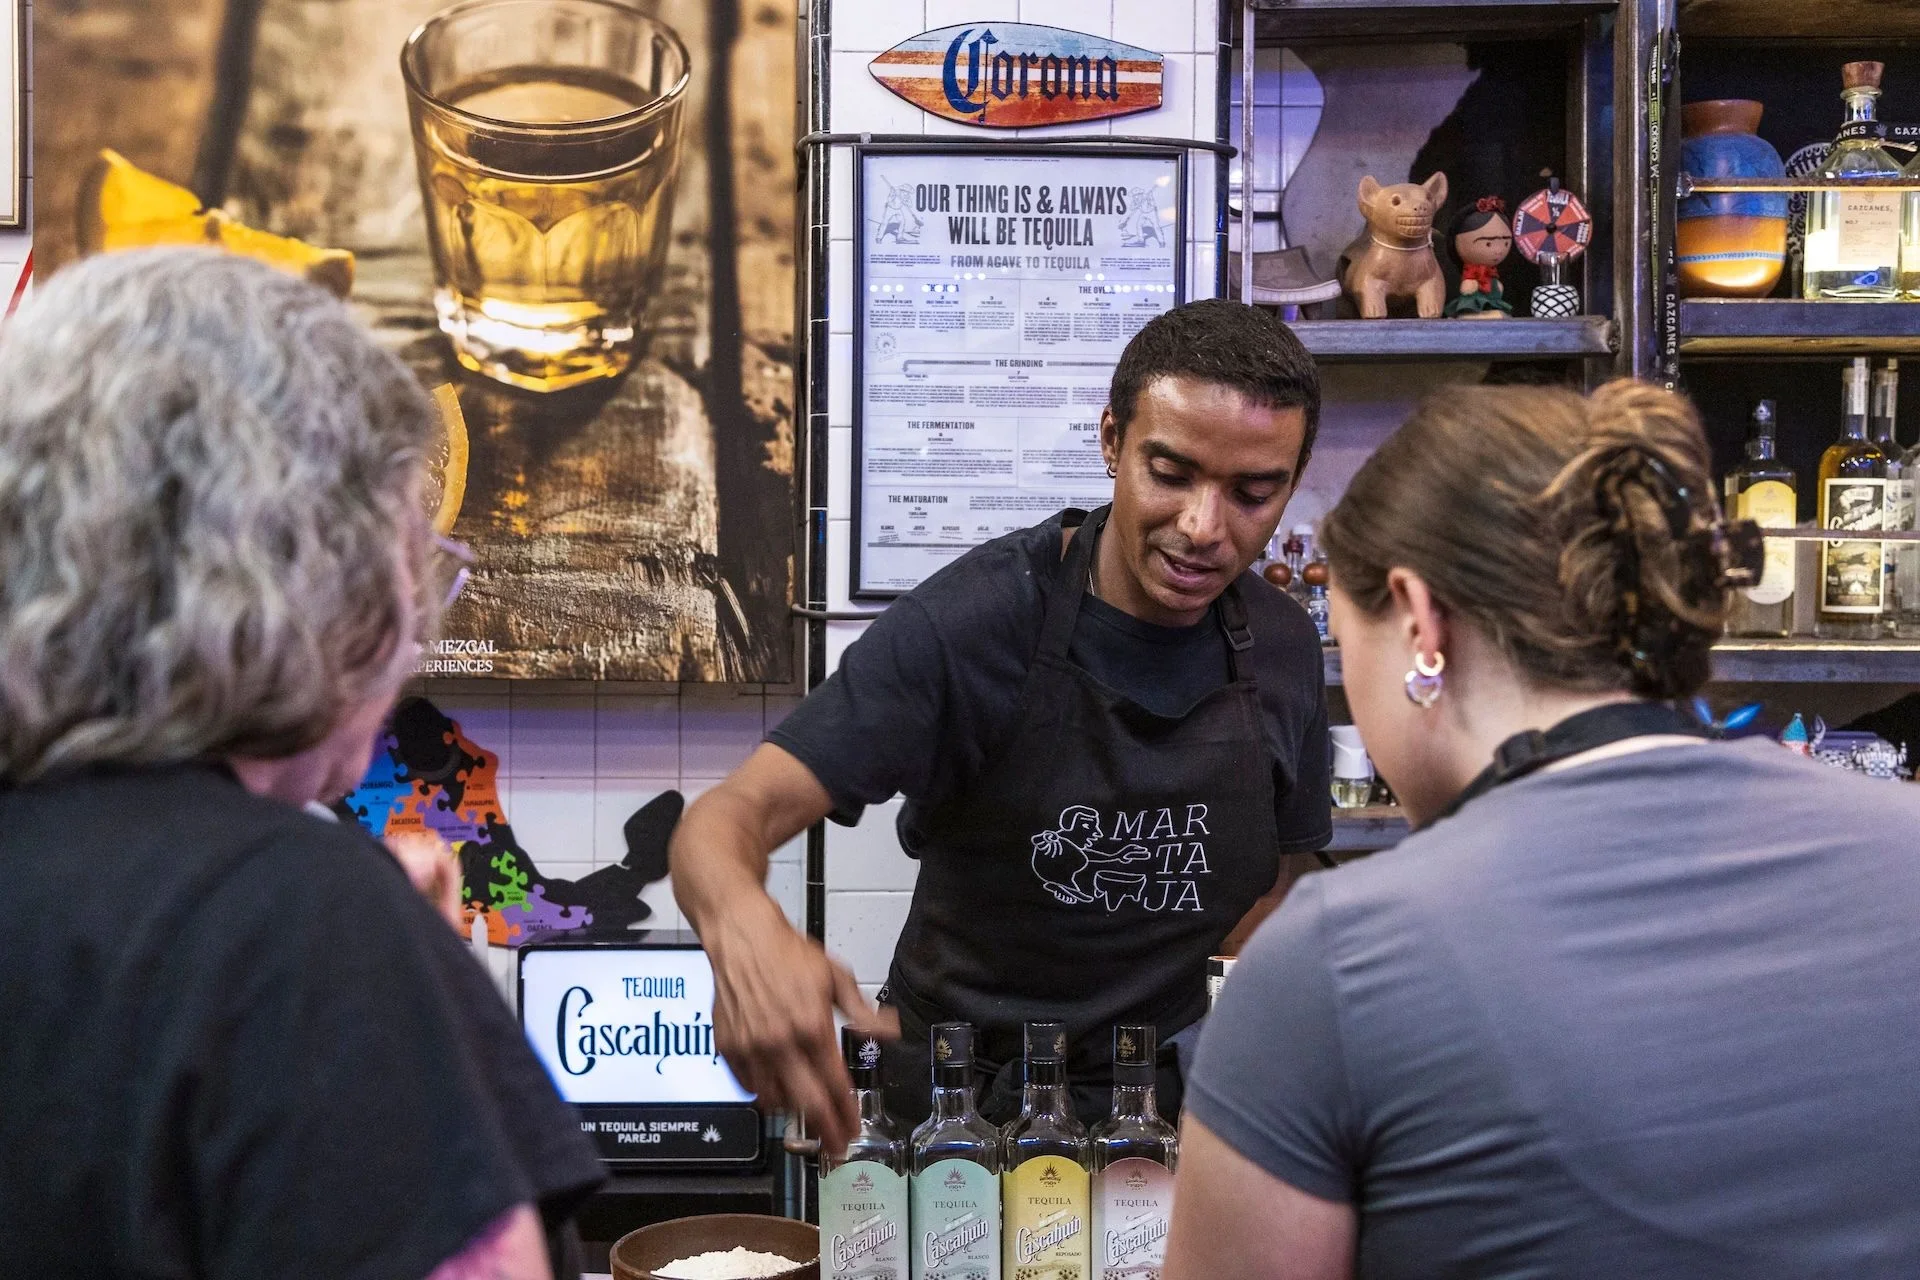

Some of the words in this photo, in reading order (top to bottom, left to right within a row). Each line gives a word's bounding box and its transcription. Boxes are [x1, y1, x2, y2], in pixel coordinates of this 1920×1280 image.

[943, 28, 1120, 114] Corona
[1895, 127, 1920, 136] CAZ
[916, 183, 950, 213] OUR
[956, 184, 1008, 213] THING
[1015, 185, 1031, 214] IS
[1037, 186, 1053, 214] &
[1059, 186, 1127, 215] ALWAYS
[948, 216, 990, 246] WILL
[996, 217, 1018, 245] BE
[1022, 217, 1094, 250] TEQUILA
[951, 255, 983, 269] FROM
[986, 255, 1022, 269] AGAVE
[1026, 256, 1041, 269] TO
[1043, 256, 1090, 272] TEQUILA
[1079, 286, 1092, 294] THE
[1666, 293, 1677, 355] CAZCANES
[995, 359, 1008, 367] THE
[1010, 359, 1043, 367] GRINDING
[907, 421, 920, 429] THE
[922, 421, 975, 430] FERMENTATION
[1069, 423, 1082, 431] THE
[888, 495, 901, 503] THE
[903, 495, 948, 504] MATURATION
[428, 639, 498, 655] MEZCAL
[1109, 804, 1210, 841] MAR
[1155, 842, 1212, 875] TA
[1143, 881, 1204, 911] JA
[622, 976, 686, 1000] TEQUILA
[580, 1122, 596, 1132] UN
[600, 1122, 646, 1132] TEQUILA
[650, 1122, 699, 1132] SIEMPRE
[617, 1133, 661, 1143] PAREJO
[933, 1200, 978, 1208] TEQUILA
[1028, 1197, 1072, 1205] TEQUILA
[1114, 1199, 1158, 1207] TEQUILA
[841, 1203, 885, 1211] TEQUILA
